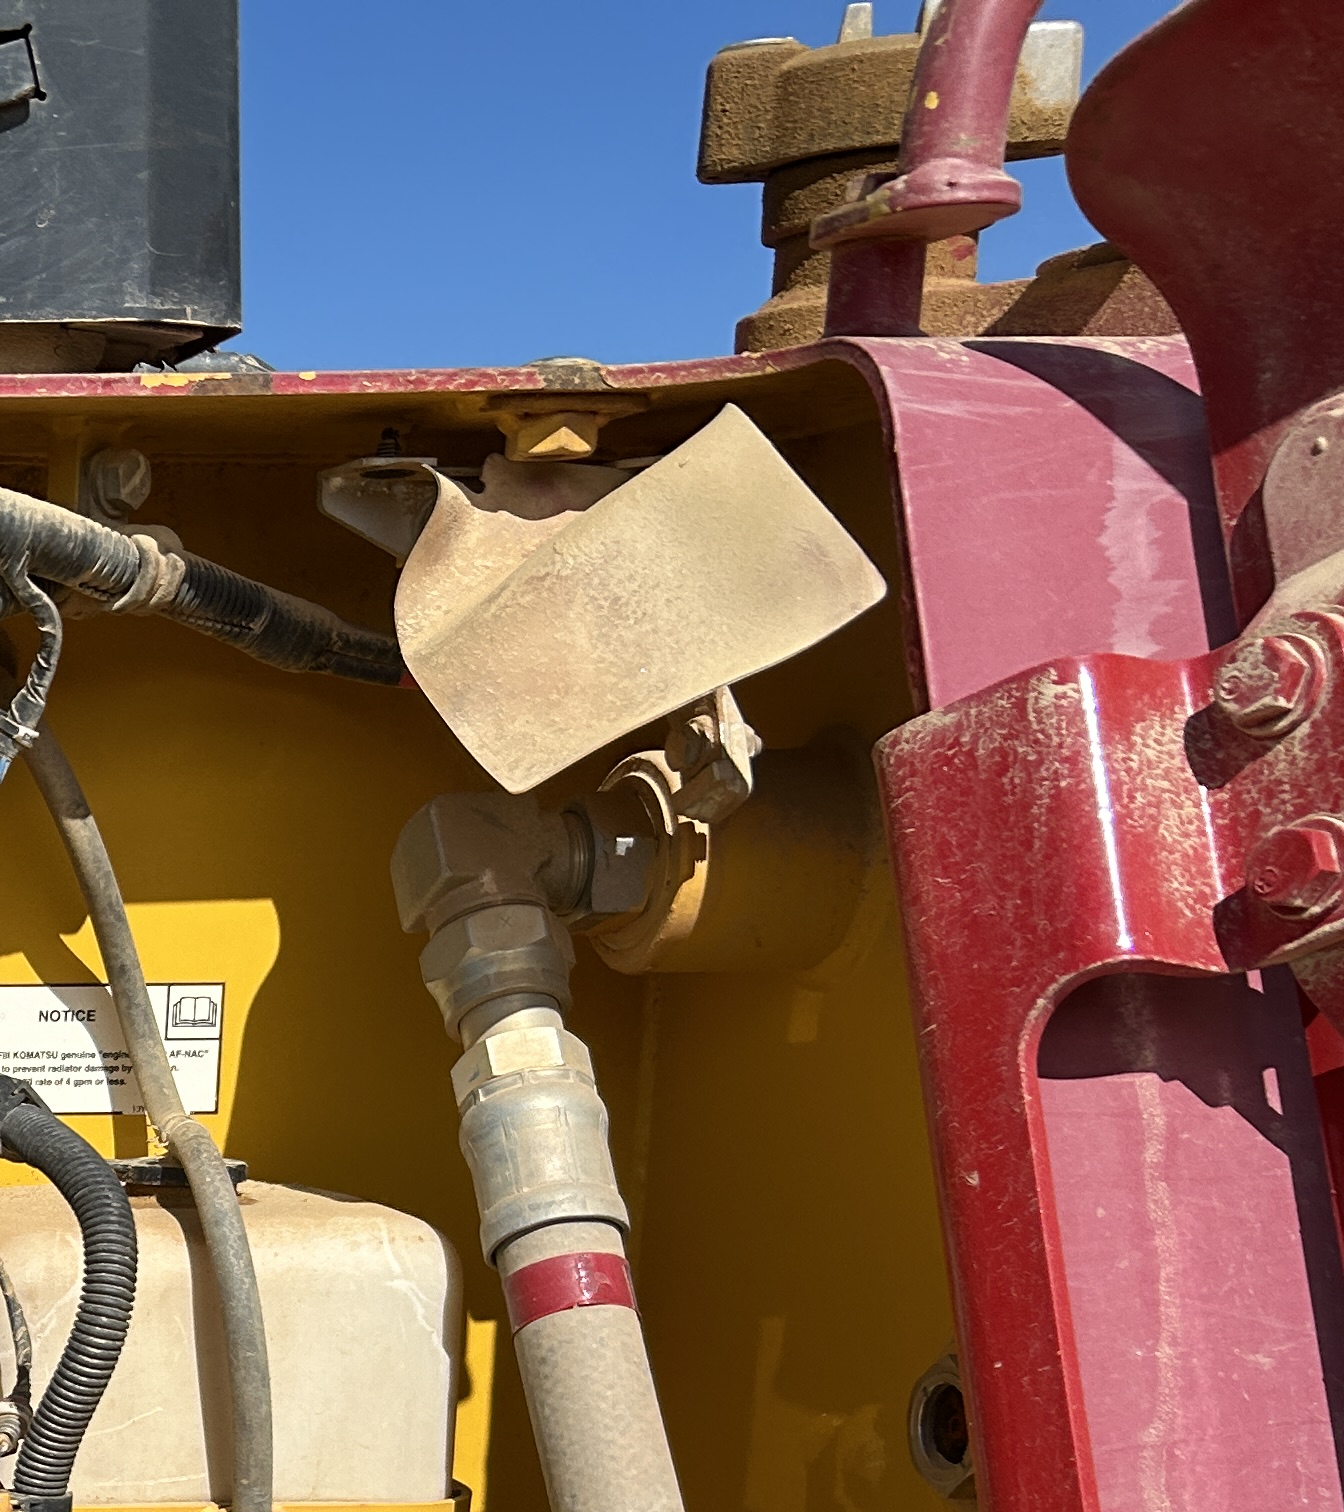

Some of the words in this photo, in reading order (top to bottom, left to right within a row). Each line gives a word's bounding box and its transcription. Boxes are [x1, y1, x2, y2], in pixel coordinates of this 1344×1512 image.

[38, 1009, 97, 1023] NOTICE
[13, 1051, 58, 1060] KOMATSU
[61, 1051, 96, 1061] genuine
[2, 1065, 11, 1073] to
[13, 1065, 46, 1074] prevent
[48, 1064, 83, 1073] radiator
[85, 1064, 120, 1074] damage
[122, 1064, 133, 1074] by
[54, 1078, 64, 1086] of
